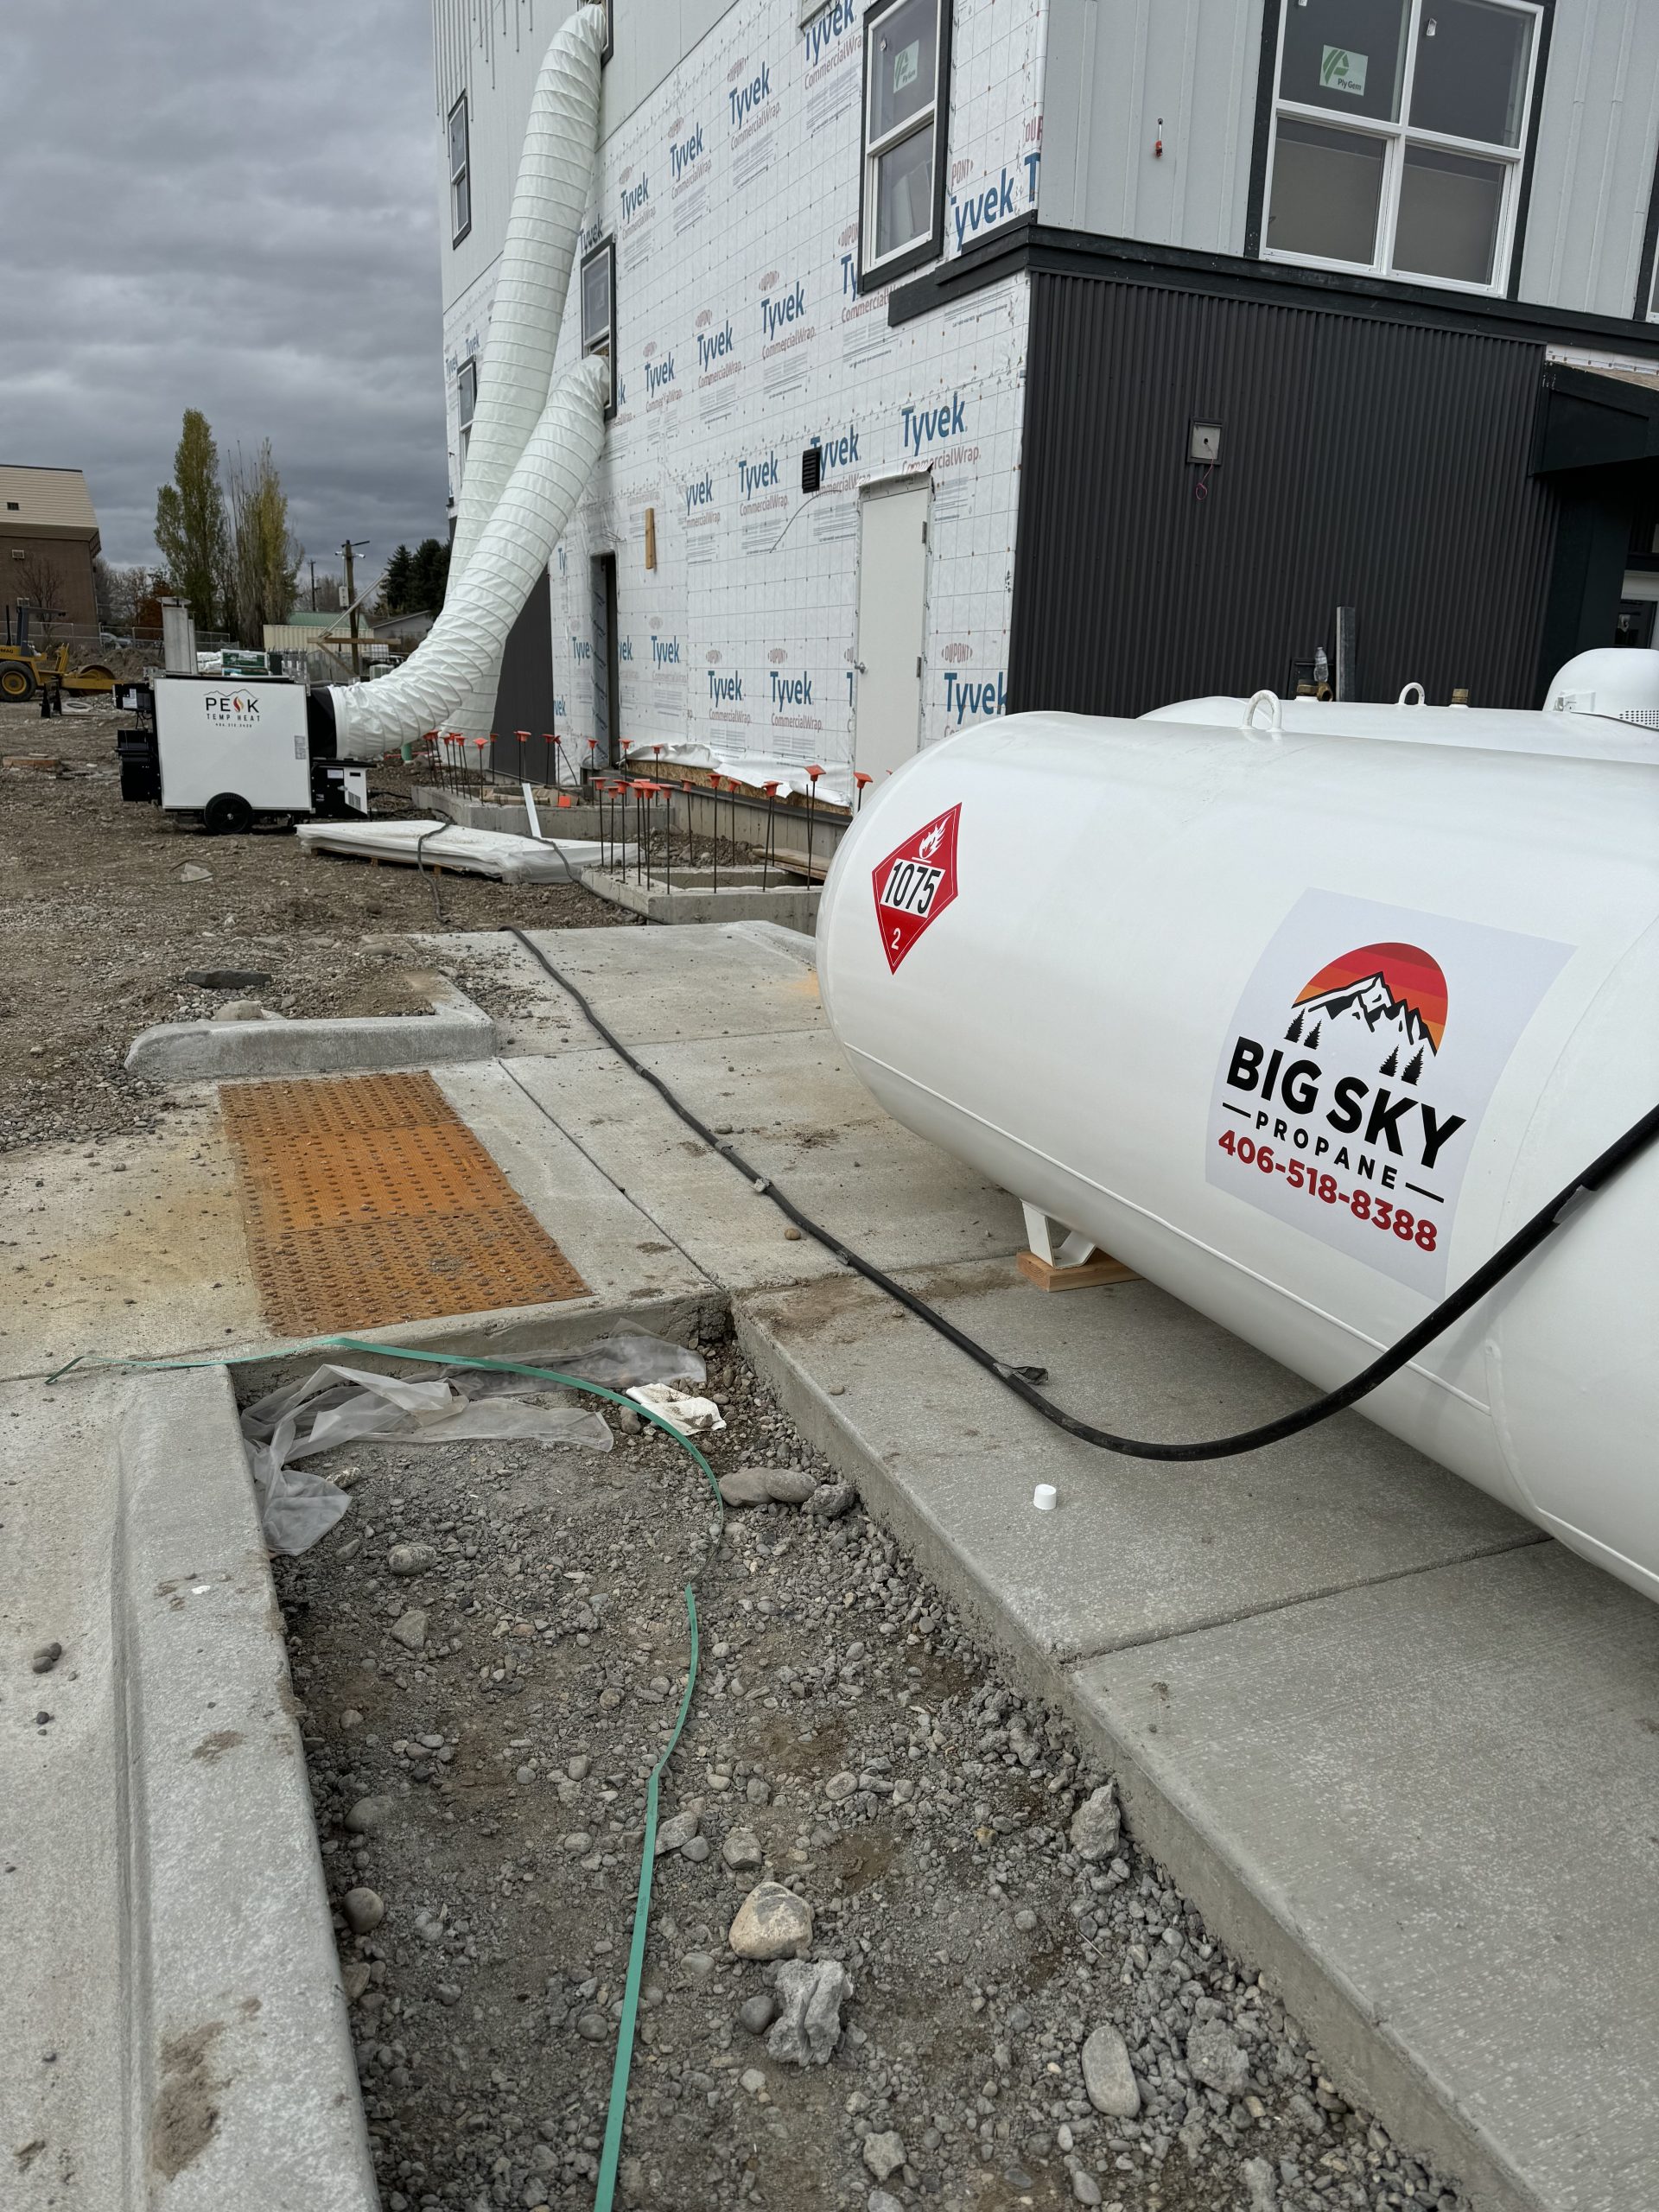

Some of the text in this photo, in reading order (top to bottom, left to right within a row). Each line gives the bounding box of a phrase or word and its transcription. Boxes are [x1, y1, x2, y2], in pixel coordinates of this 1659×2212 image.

[804, 35, 862, 90] CommercialWra
[1338, 78, 1347, 89] Ply
[729, 60, 770, 130] Tyvek
[731, 101, 780, 150] CommercialWrap
[671, 122, 703, 183] Tyvek
[621, 171, 649, 224] Tyvek
[951, 168, 1014, 252] yvek
[761, 281, 804, 340] Tyvek
[697, 320, 733, 372] Tyvek
[762, 326, 816, 360] CommercialWrap
[645, 352, 675, 398] Tyvek
[901, 391, 965, 456] Tyvek
[686, 472, 713, 516] yvek
[739, 450, 779, 500] Tyvek
[572, 636, 590, 666] Tyve
[651, 635, 679, 670] Tyvek
[708, 671, 742, 708] Tyvek
[770, 671, 812, 713] Tyvek
[771, 713, 823, 733] CommercialWrap
[885, 861, 941, 914] 1075
[891, 927, 901, 950] 2
[1226, 1036, 1467, 1169] BIG SKY
[1255, 1110, 1398, 1190] PROPANE
[1218, 1129, 1438, 1252] 406-518-8388
